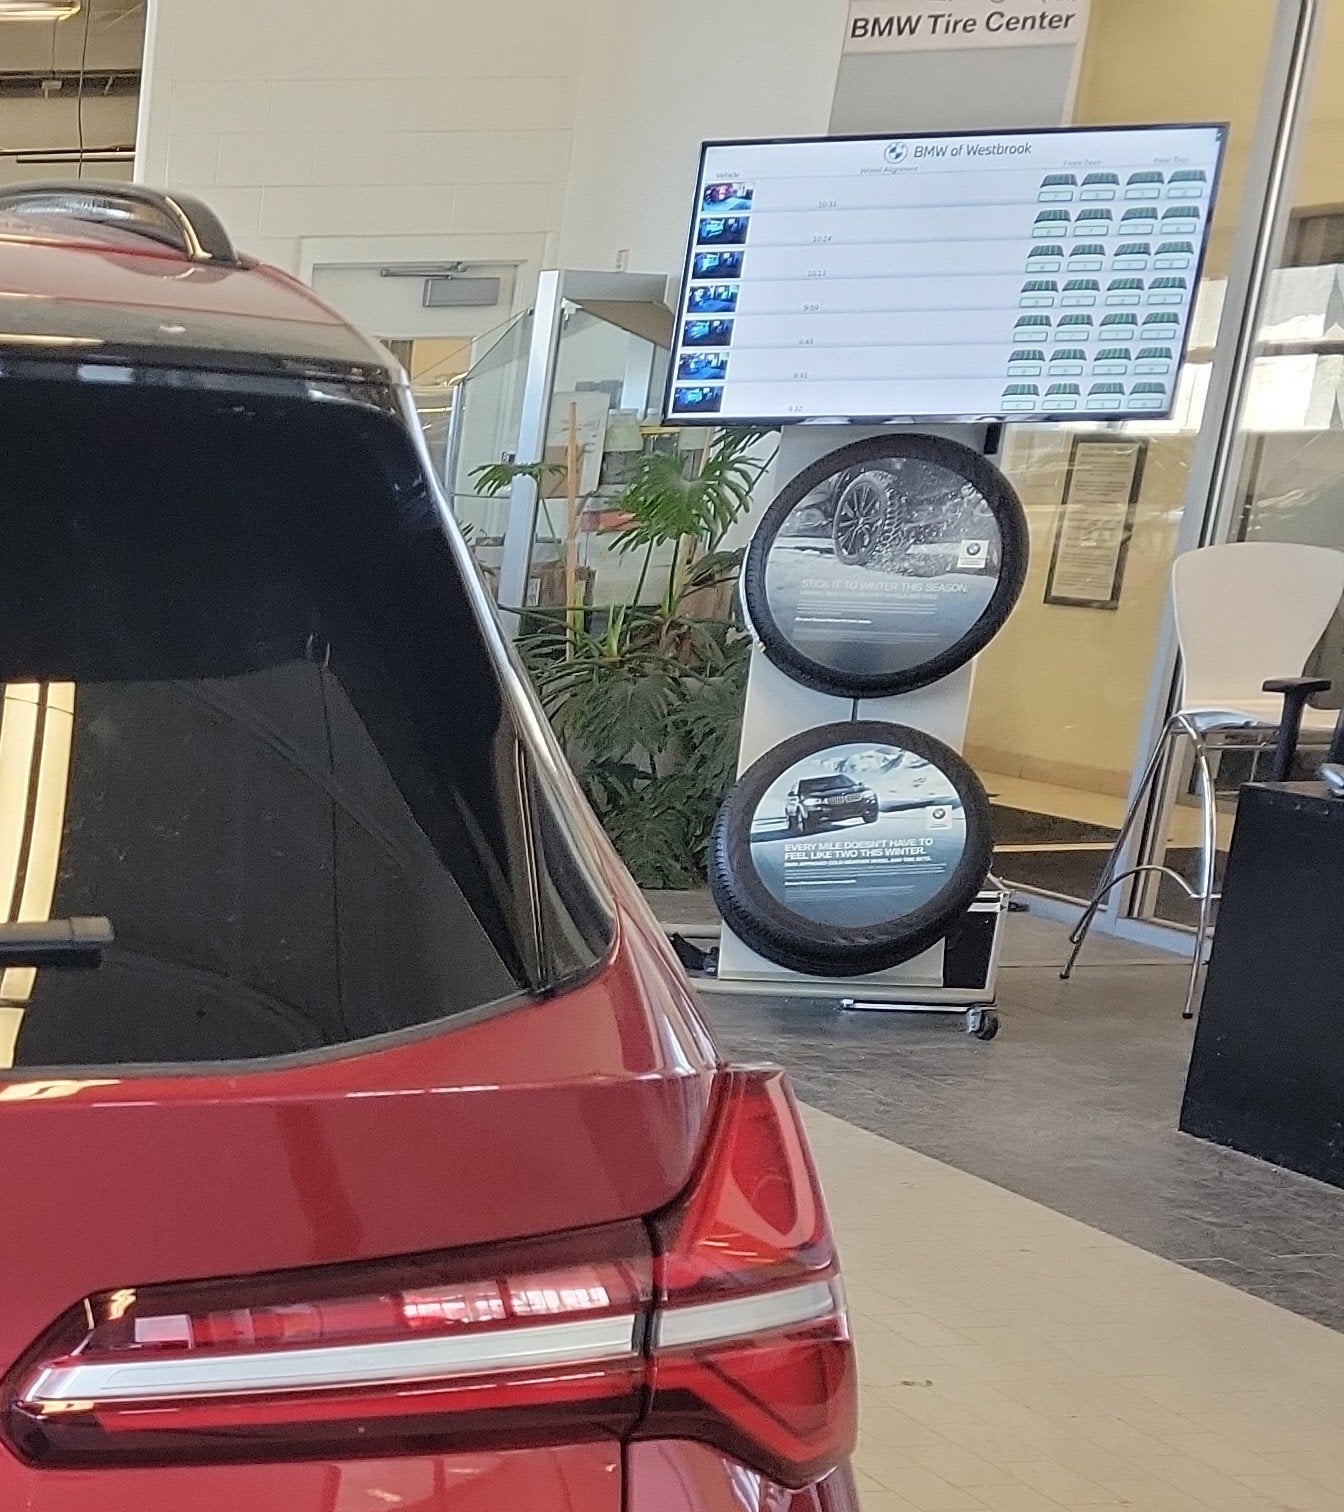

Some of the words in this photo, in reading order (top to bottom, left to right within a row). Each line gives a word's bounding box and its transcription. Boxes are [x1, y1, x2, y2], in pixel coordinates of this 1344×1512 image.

[850, 14, 923, 39] BMW
[927, 12, 978, 35] Tire
[984, 10, 1077, 33] Center
[913, 144, 949, 158] BMW
[950, 144, 965, 157] of
[965, 142, 1033, 157] Westbrook
[902, 582, 924, 592] THIS
[785, 843, 817, 852] EVERY
[818, 842, 843, 851] MILE
[844, 839, 887, 850] DOESN'T
[889, 838, 917, 848] HAVE
[918, 837, 934, 847] TO
[784, 851, 810, 861] FEEL
[810, 850, 833, 860] LIKE
[834, 849, 859, 859] TWO
[860, 848, 884, 858] THIS
